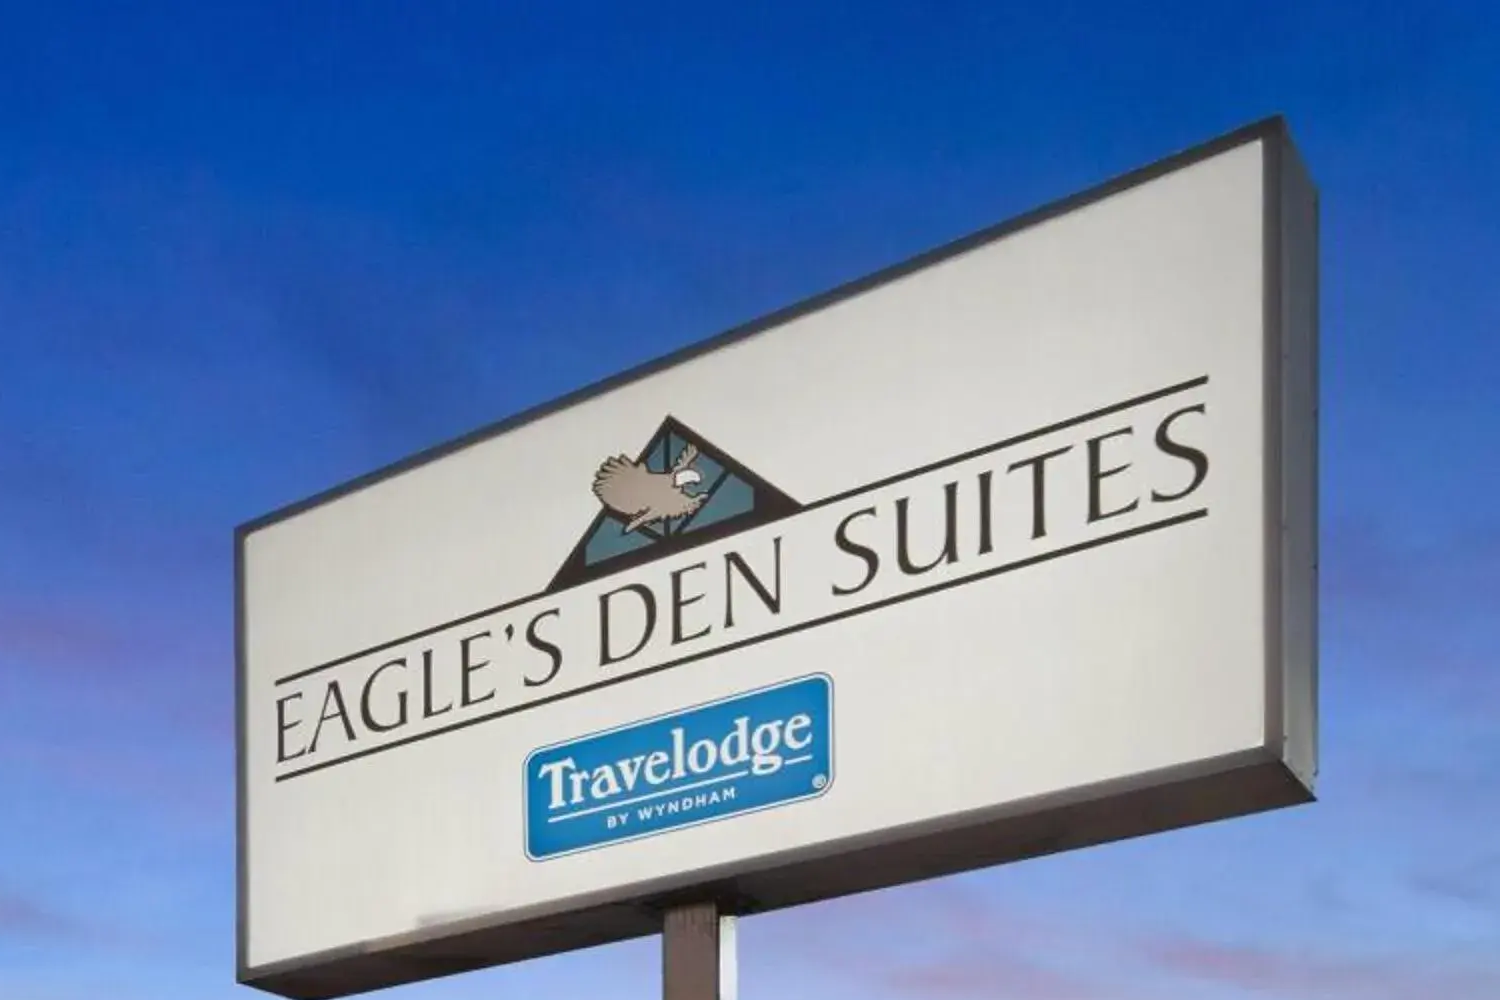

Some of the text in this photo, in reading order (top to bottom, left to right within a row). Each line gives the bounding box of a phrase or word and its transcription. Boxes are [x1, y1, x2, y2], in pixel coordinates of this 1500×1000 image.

[275, 403, 1210, 764] EAGLE'S DEN SUITES
[539, 713, 813, 809] Travelodge
[606, 787, 737, 830] BY WYNDHAM
